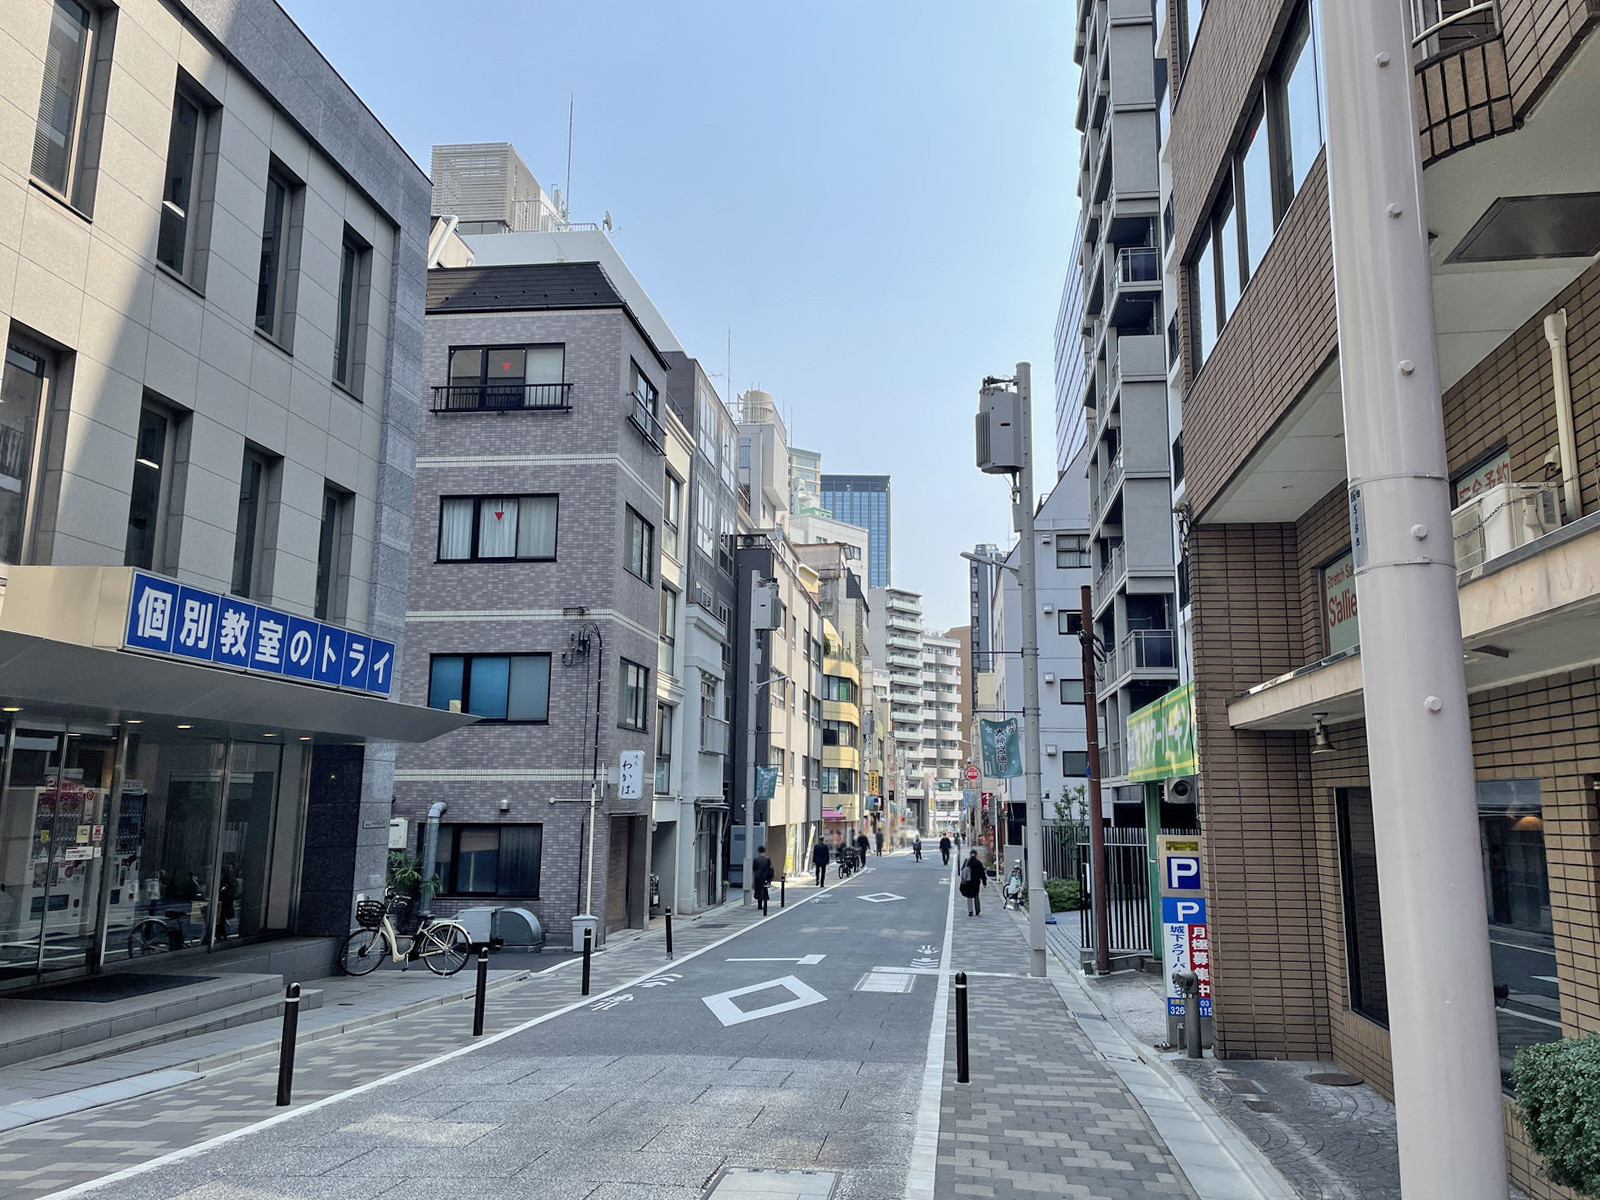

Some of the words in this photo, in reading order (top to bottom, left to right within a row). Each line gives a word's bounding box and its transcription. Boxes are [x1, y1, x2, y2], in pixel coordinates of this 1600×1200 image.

[137, 586, 390, 684] 個別教室のトライ
[995, 728, 1007, 773] 大神宮通り
[1171, 858, 1198, 888] P
[1177, 902, 1200, 922] P
[1192, 926, 1210, 997] 月極募集中
